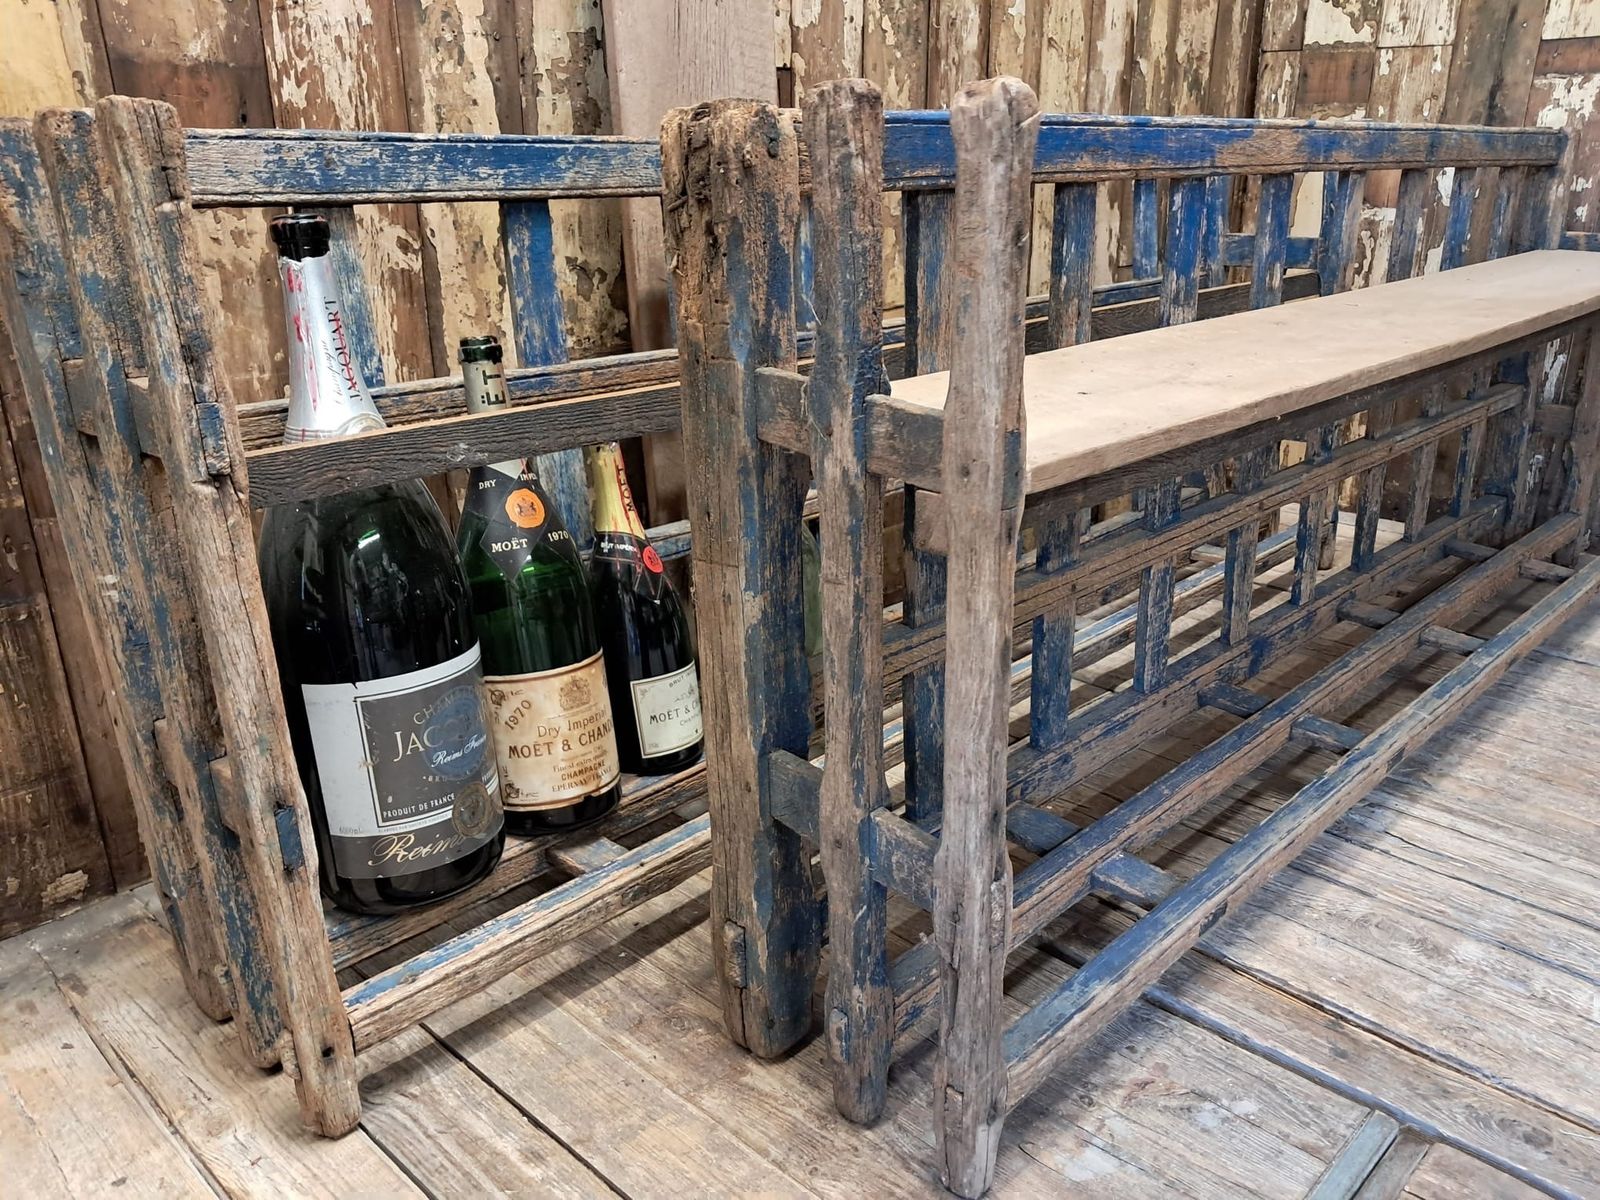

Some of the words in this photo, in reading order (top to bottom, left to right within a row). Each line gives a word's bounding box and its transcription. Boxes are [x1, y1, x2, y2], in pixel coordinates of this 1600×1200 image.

[323, 297, 363, 402] JACQUART
[478, 479, 497, 490] DRY
[547, 530, 569, 542] 1970
[491, 537, 528, 553] MOËT
[504, 700, 532, 731] 1970
[684, 704, 691, 714] &
[537, 725, 561, 738] Dry
[561, 738, 573, 752] &
[561, 759, 606, 782] CHAMPAGNE
[383, 805, 416, 819] PRODUIT
[418, 803, 429, 811] DE
[430, 793, 456, 807] FRANCE
